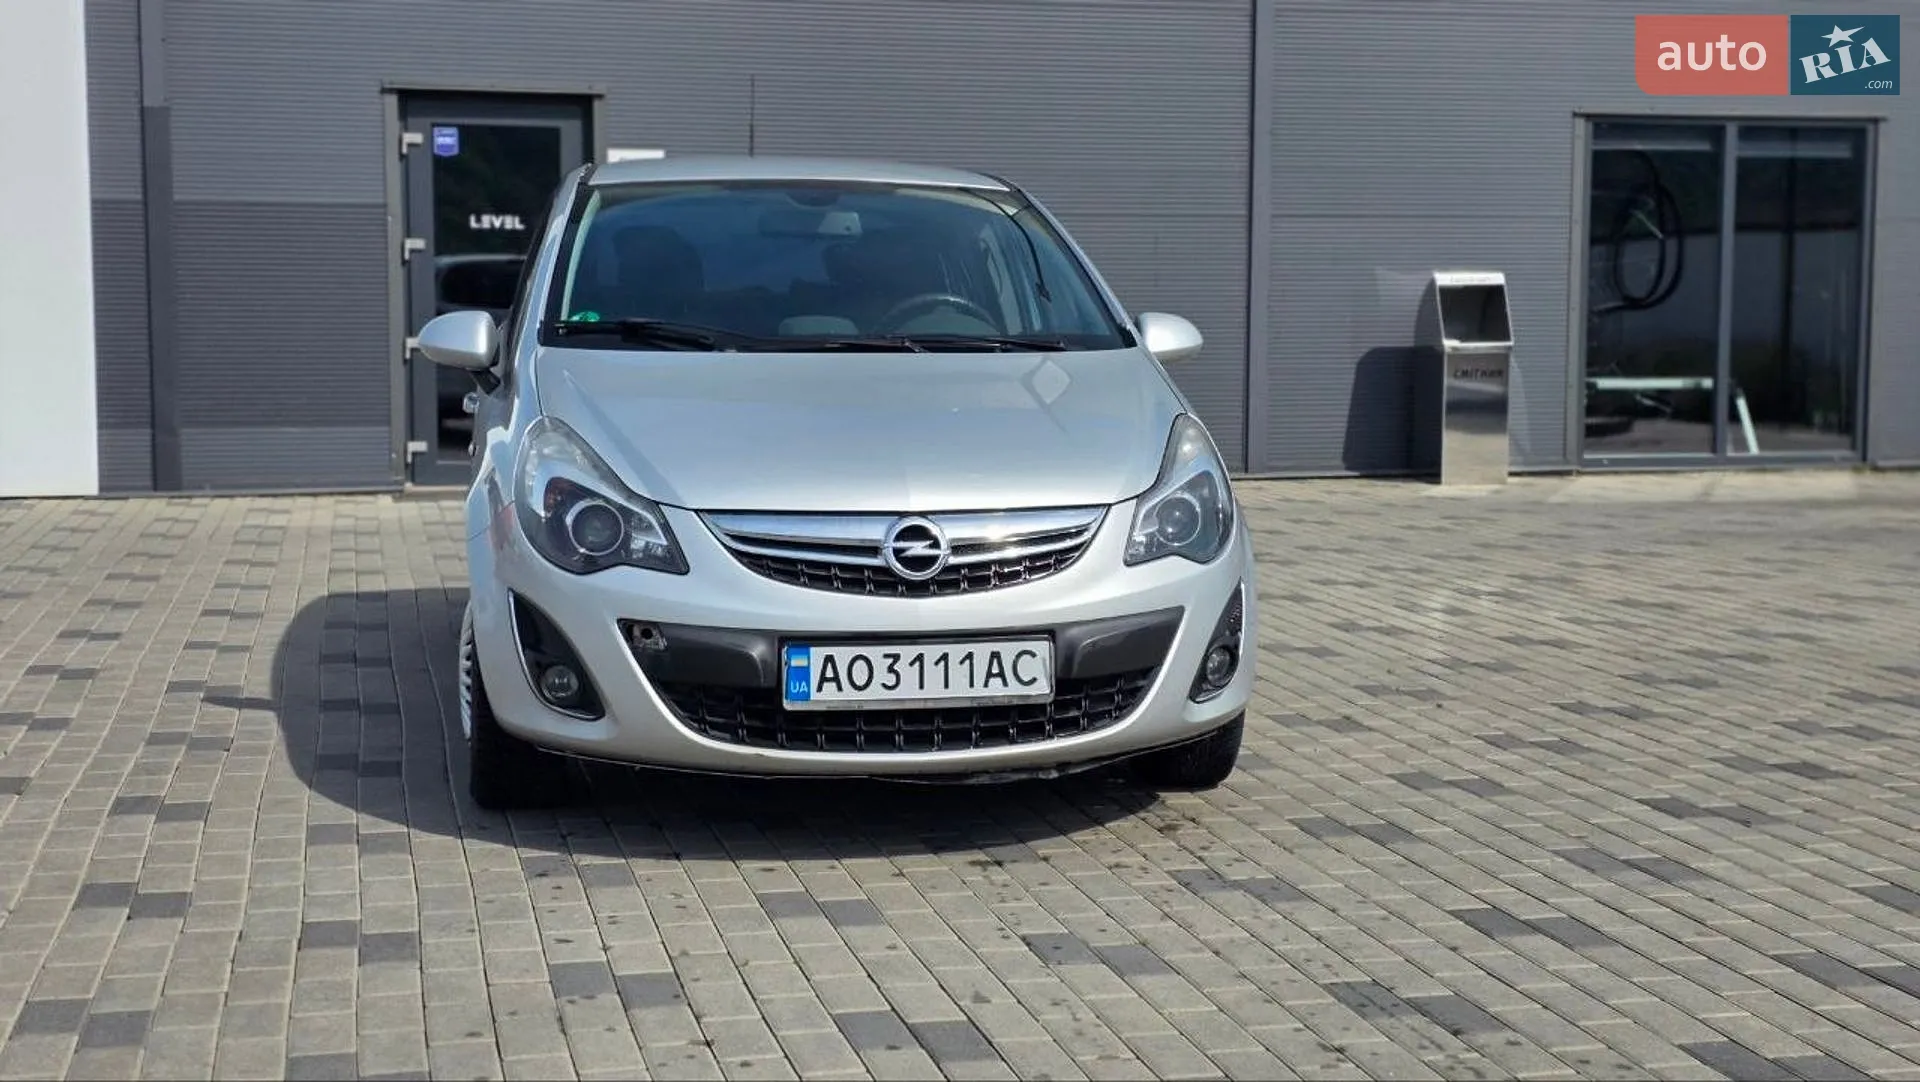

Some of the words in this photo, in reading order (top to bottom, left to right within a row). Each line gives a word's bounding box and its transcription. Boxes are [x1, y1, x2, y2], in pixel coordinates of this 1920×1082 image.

[469, 213, 525, 230] LEVEL
[790, 681, 808, 693] UA
[816, 649, 1039, 693] AO3111AC
